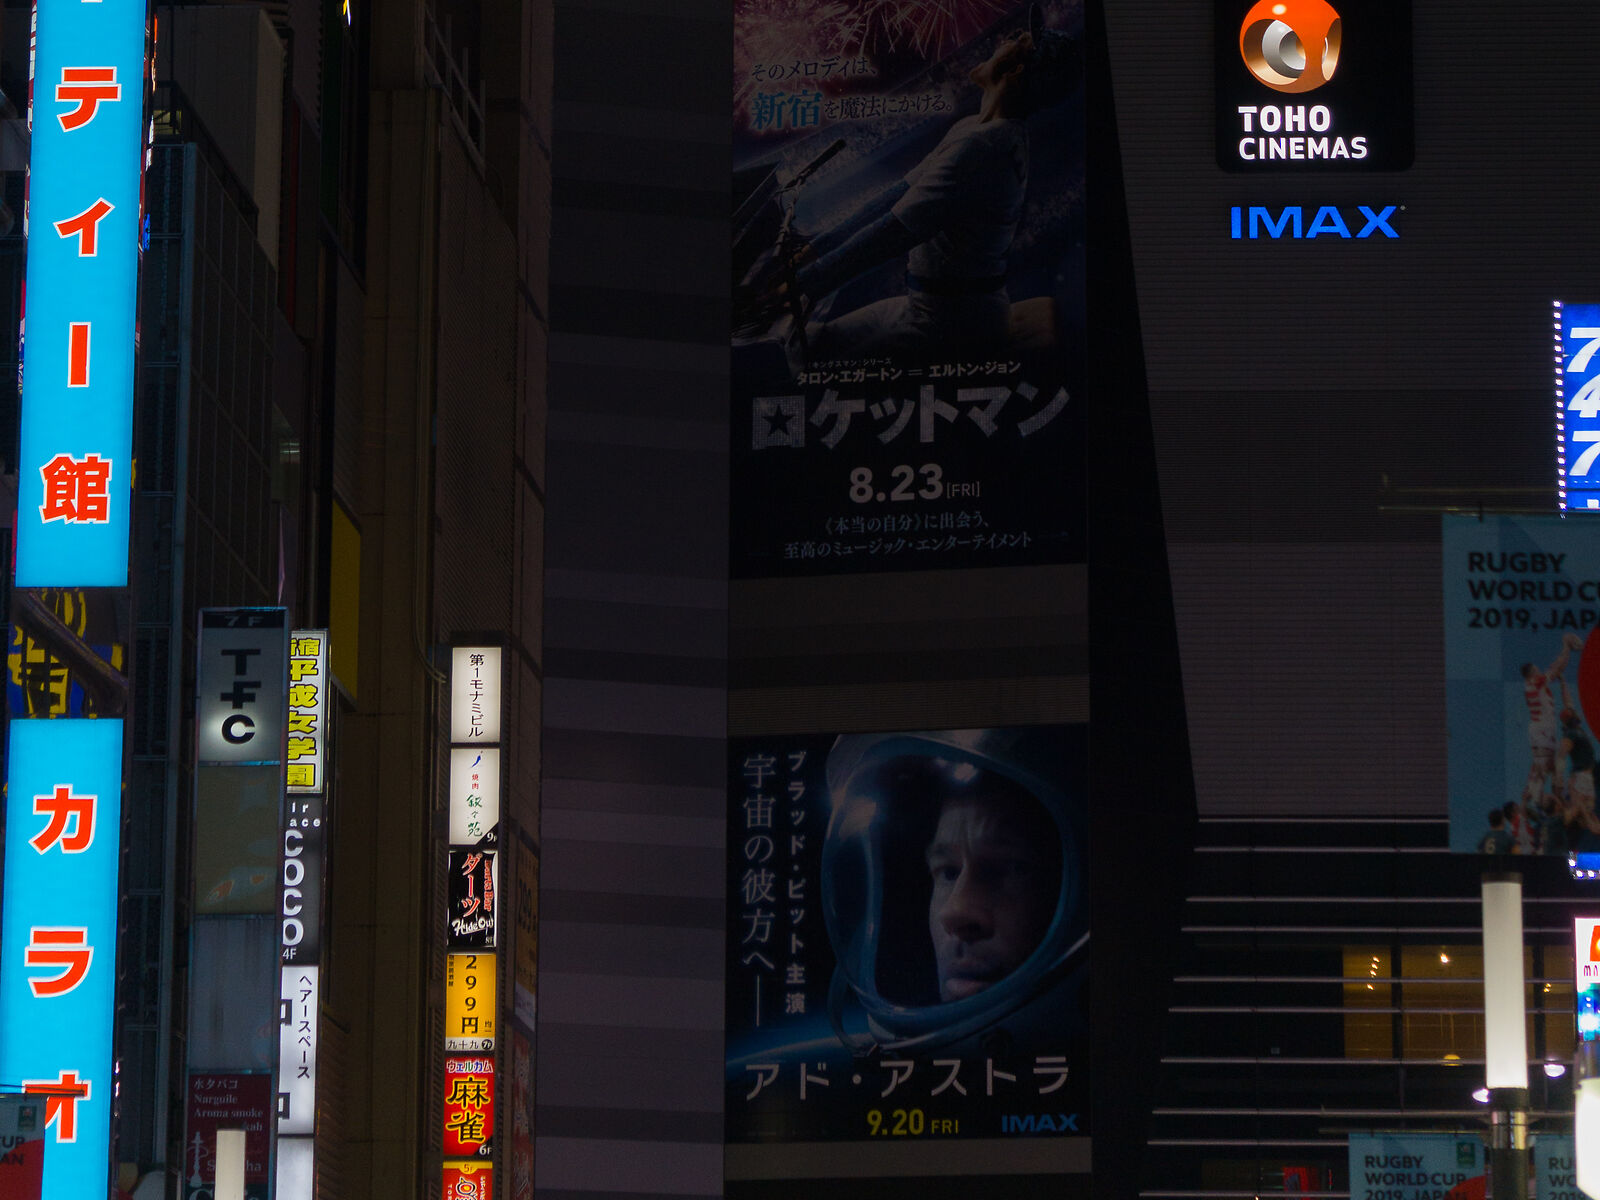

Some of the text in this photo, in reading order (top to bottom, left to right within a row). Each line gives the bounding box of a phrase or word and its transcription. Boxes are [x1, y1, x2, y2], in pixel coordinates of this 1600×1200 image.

[1238, 105, 1332, 132] TOHO
[1238, 137, 1368, 160] CINEMAS
[1230, 206, 1400, 239] IMAX
[752, 381, 1071, 450] ロケットマン
[849, 462, 944, 503] 8.23
[1468, 552, 1566, 573] RUGBY
[1468, 580, 1600, 601] WORLD C
[1468, 607, 1538, 632] 2019,
[461, 852, 483, 918] ダーツ
[297, 974, 313, 1080] ヘアースペース
[194, 1078, 239, 1090] 水タバコ
[745, 1056, 1069, 1101] アド・アストラ
[445, 1075, 491, 1145] 麻雀
[866, 1109, 1079, 1137] 9.20 FRI IMAX
[1364, 1155, 1425, 1169] RUGBY
[1365, 1172, 1467, 1186] WORLD CUP
